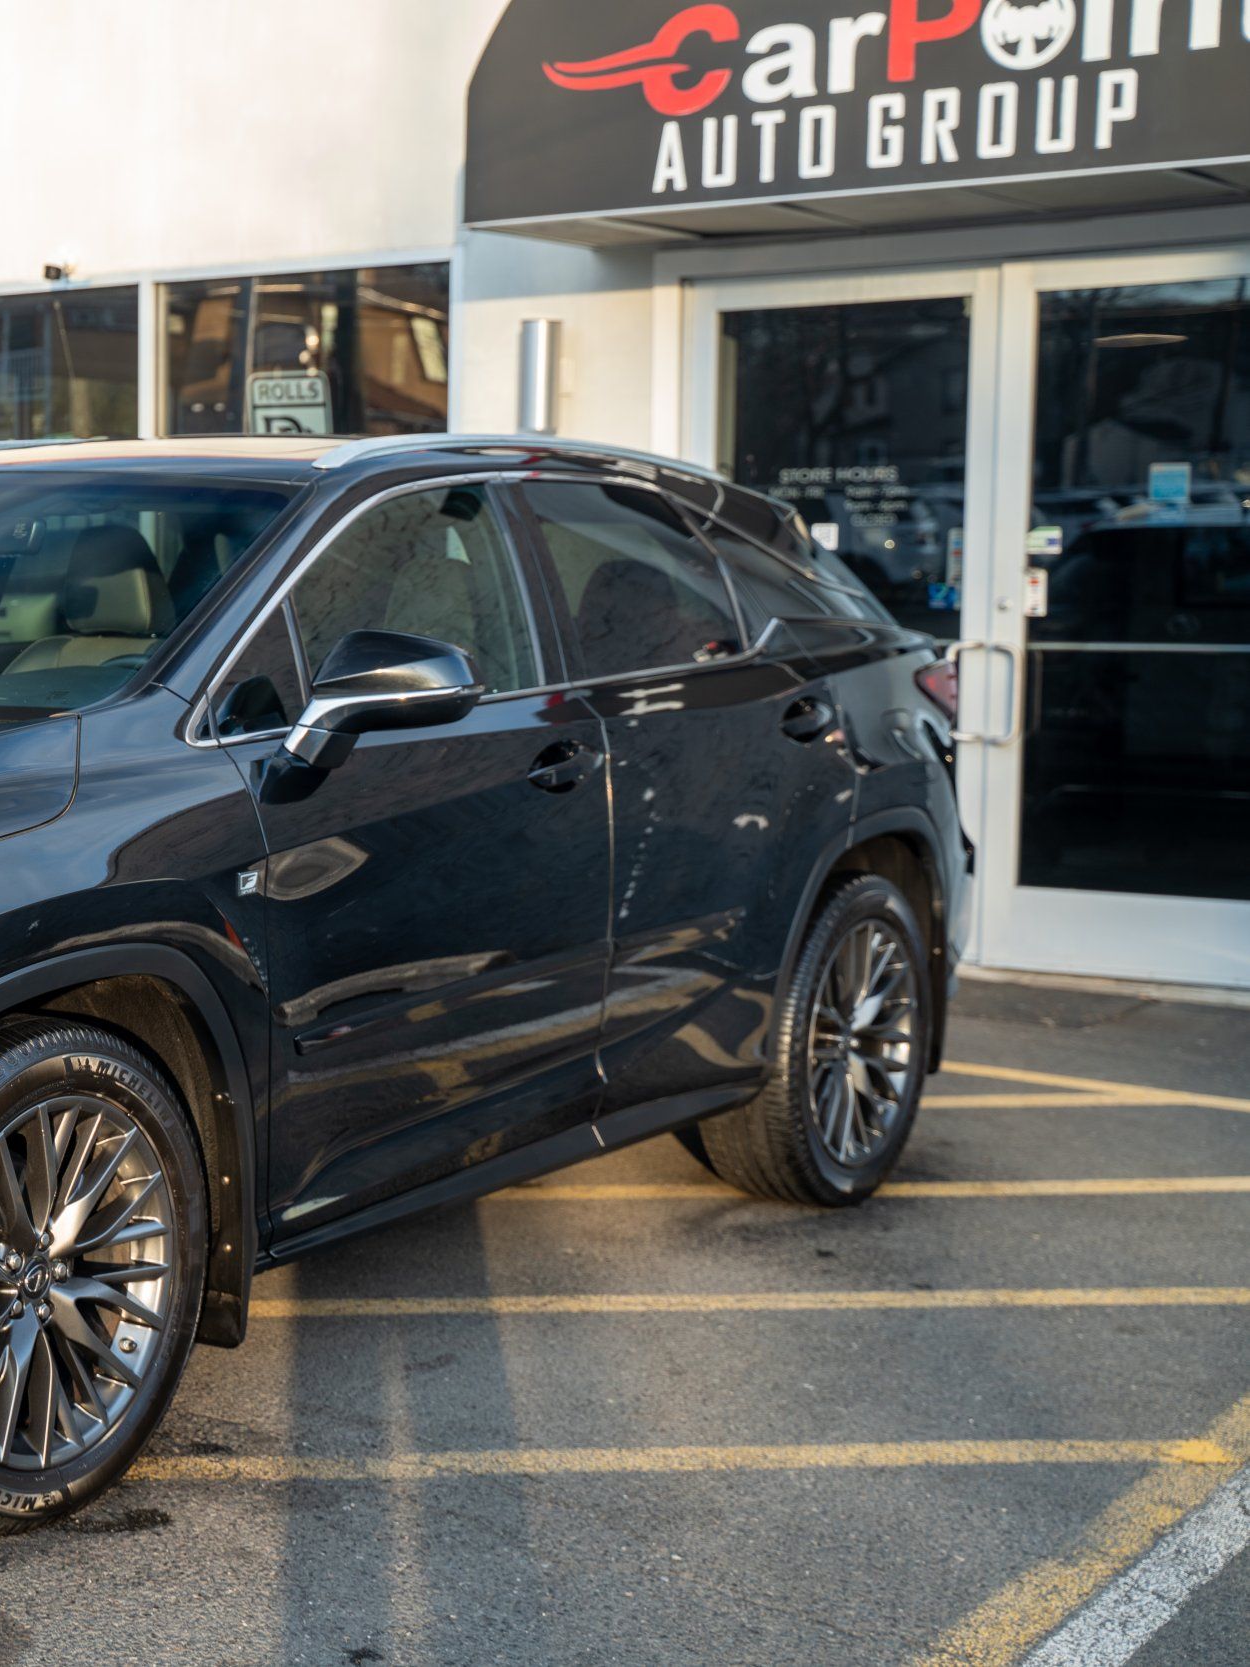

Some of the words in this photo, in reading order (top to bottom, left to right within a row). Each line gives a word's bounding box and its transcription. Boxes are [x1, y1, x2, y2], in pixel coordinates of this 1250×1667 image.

[543, 0, 1250, 116] CarPoin
[651, 105, 837, 194] AUTO
[866, 68, 1139, 169] GROUP
[257, 381, 320, 400] ROLLS
[779, 468, 833, 484] STORE
[836, 466, 899, 482] HOURS
[95, 1060, 176, 1129] MICHELIN
